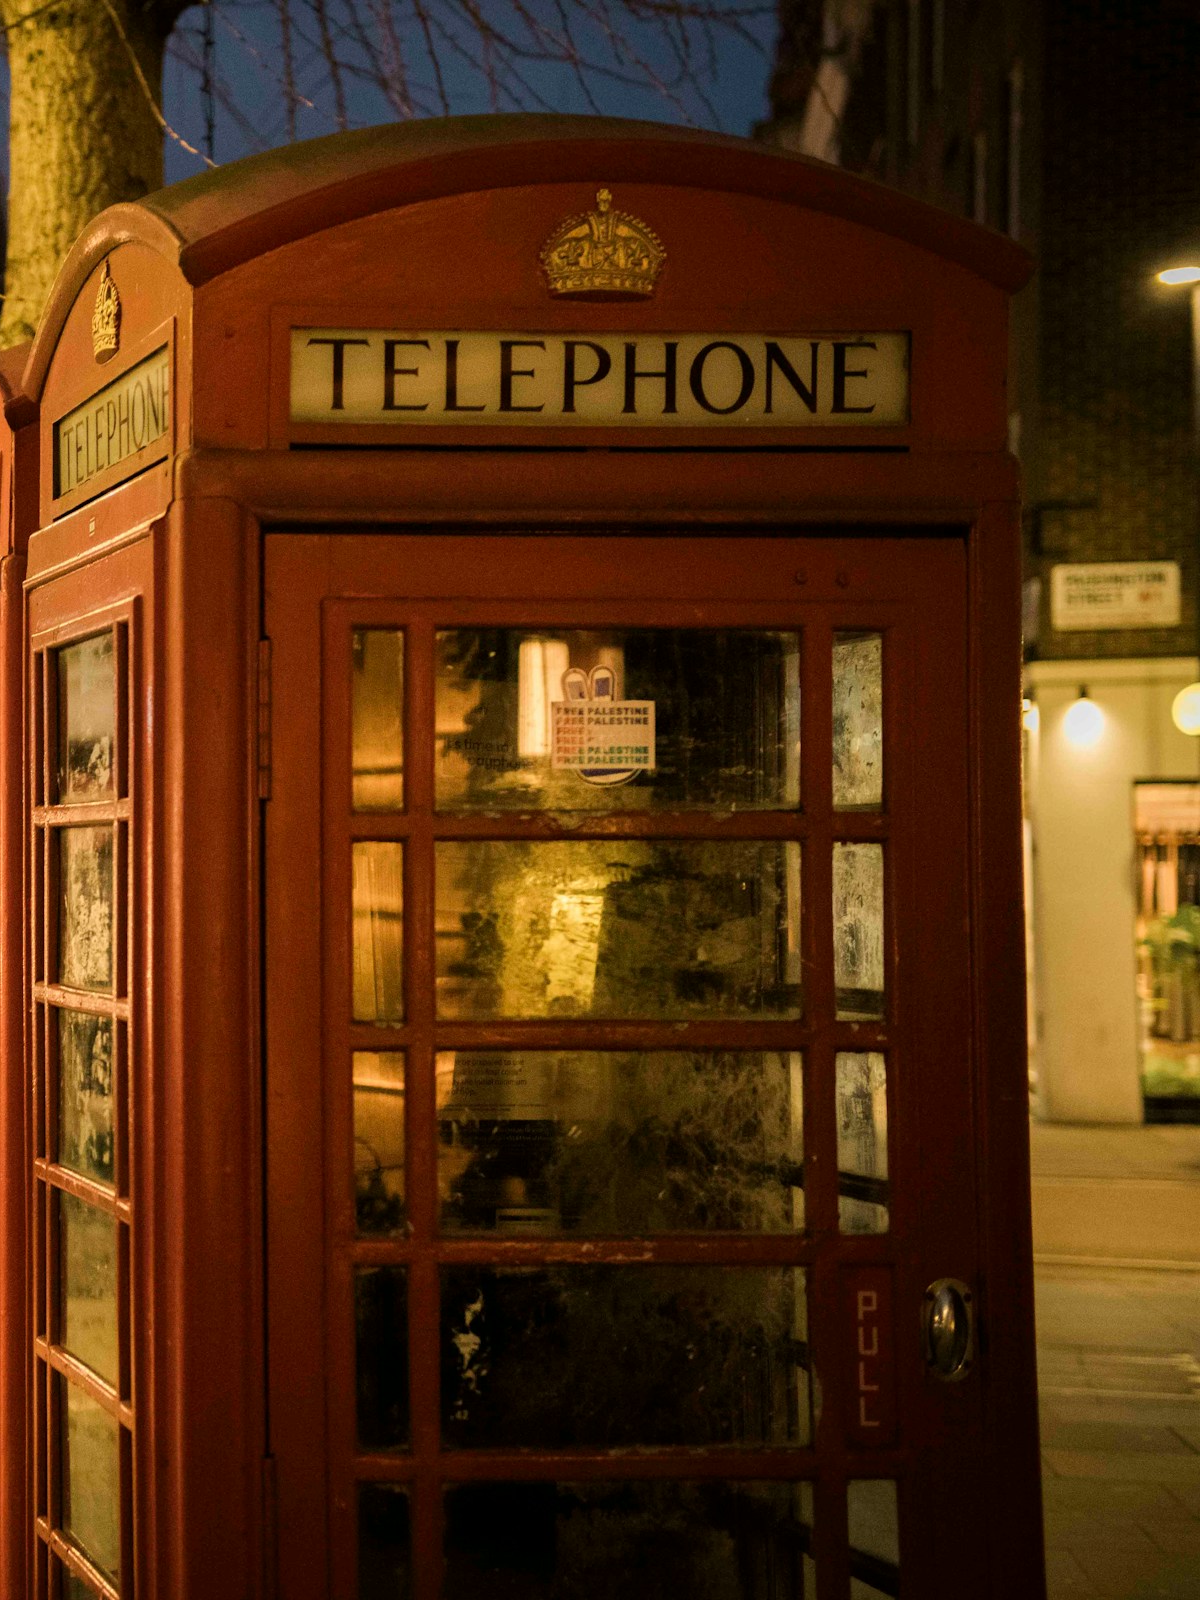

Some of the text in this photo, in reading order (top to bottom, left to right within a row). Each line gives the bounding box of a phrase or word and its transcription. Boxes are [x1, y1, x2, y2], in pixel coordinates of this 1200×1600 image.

[307, 338, 878, 415] TELEPHONE
[63, 363, 169, 489] TELEPHONE
[587, 707, 649, 715] PALESTINE
[587, 717, 649, 725] PALESTINE
[587, 756, 649, 764] PALESTINE
[857, 1291, 880, 1427] PULL
